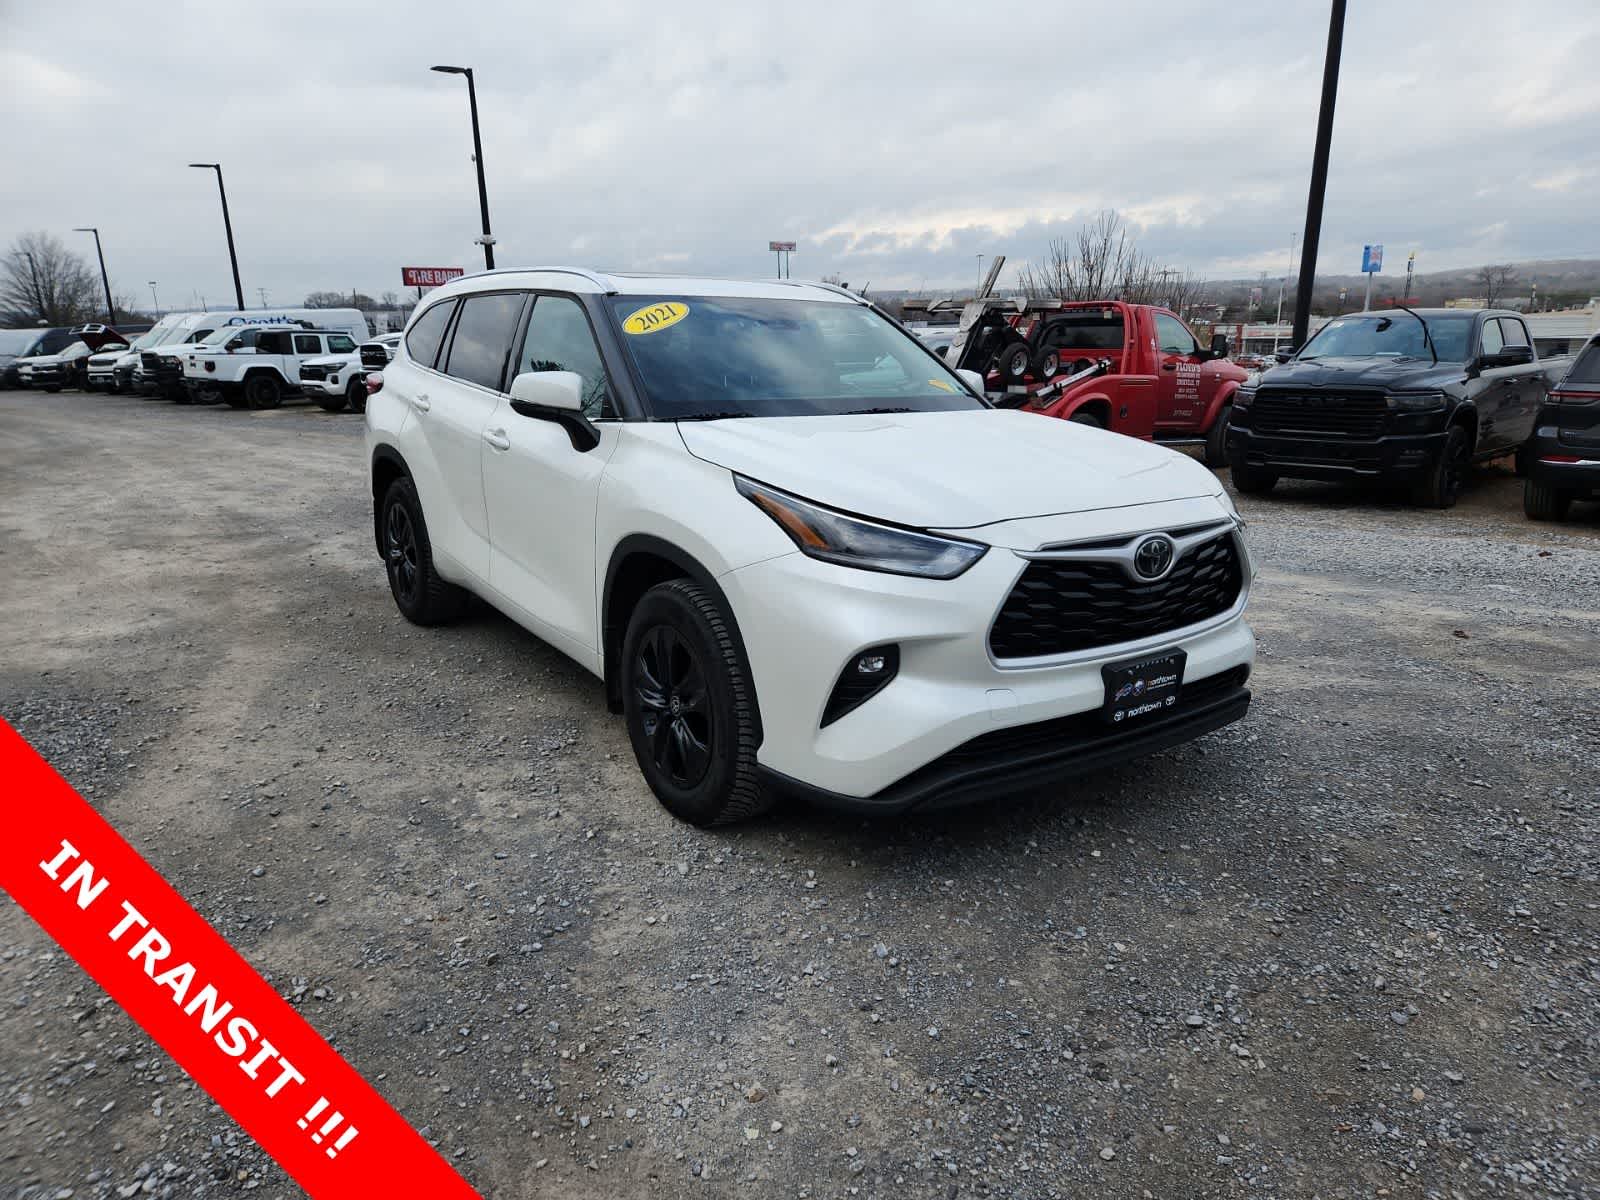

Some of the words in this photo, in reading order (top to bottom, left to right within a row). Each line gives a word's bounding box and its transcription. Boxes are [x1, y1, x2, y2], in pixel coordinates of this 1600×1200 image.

[408, 270, 434, 284] TIRE
[635, 304, 677, 330] 2021
[1148, 673, 1177, 687] northtown
[1127, 701, 1162, 718] northtown
